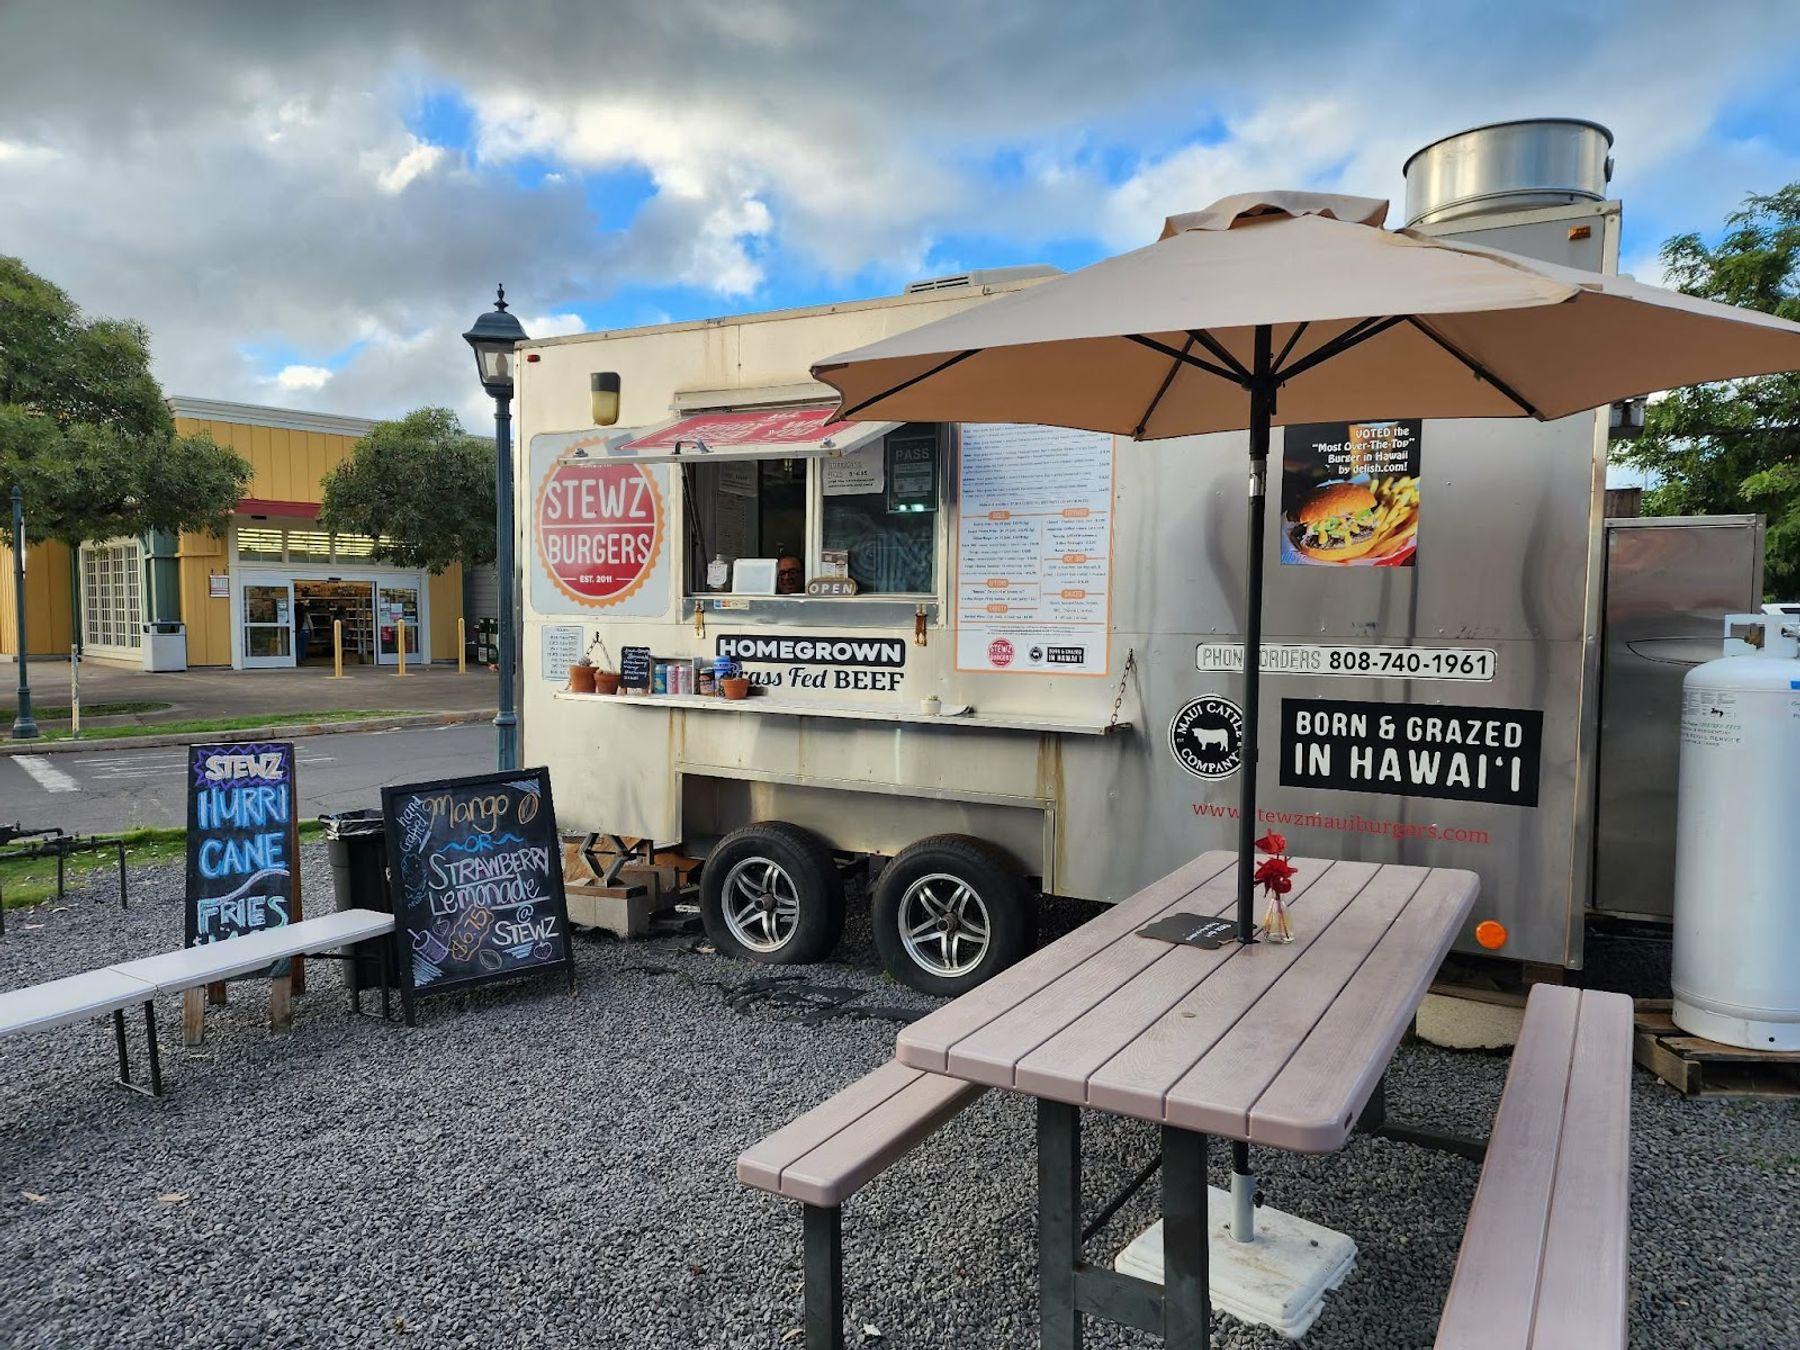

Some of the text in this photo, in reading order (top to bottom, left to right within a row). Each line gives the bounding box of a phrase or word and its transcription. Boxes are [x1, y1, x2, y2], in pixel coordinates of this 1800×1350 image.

[1356, 427, 1410, 439] VOTED the
[895, 448, 930, 460] PASS
[1328, 451, 1409, 464] Burger in Hawaii
[1338, 462, 1408, 475] by delish.com!
[546, 477, 647, 519] STEWZ
[547, 533, 651, 565] BURGERS
[580, 575, 612, 583] EST. 2011
[809, 584, 853, 594] OPEN
[719, 639, 901, 663] HOMEGROWN
[1203, 648, 1488, 675] PHON ORDERS 808-740-1961
[788, 667, 828, 688] Fed
[833, 670, 905, 691] BEEF
[1176, 704, 1204, 735] MAUI
[1295, 711, 1523, 749] BORN & GRAZED
[205, 752, 284, 781] STEWZ
[1181, 748, 1240, 773] COMPANY
[1294, 743, 1331, 777] IN
[197, 784, 290, 830] HURRI
[395, 795, 424, 827] hand
[422, 794, 510, 834] Mango
[1192, 803, 1490, 844] wwwtewzmauiburgers.com
[198, 832, 290, 879] CANE
[464, 834, 494, 853] OR
[428, 874, 540, 916] Lemonade
[197, 895, 290, 934] FRIES
[516, 904, 534, 923] @
[451, 909, 487, 958] $6.75
[491, 916, 560, 946] STEWZ
